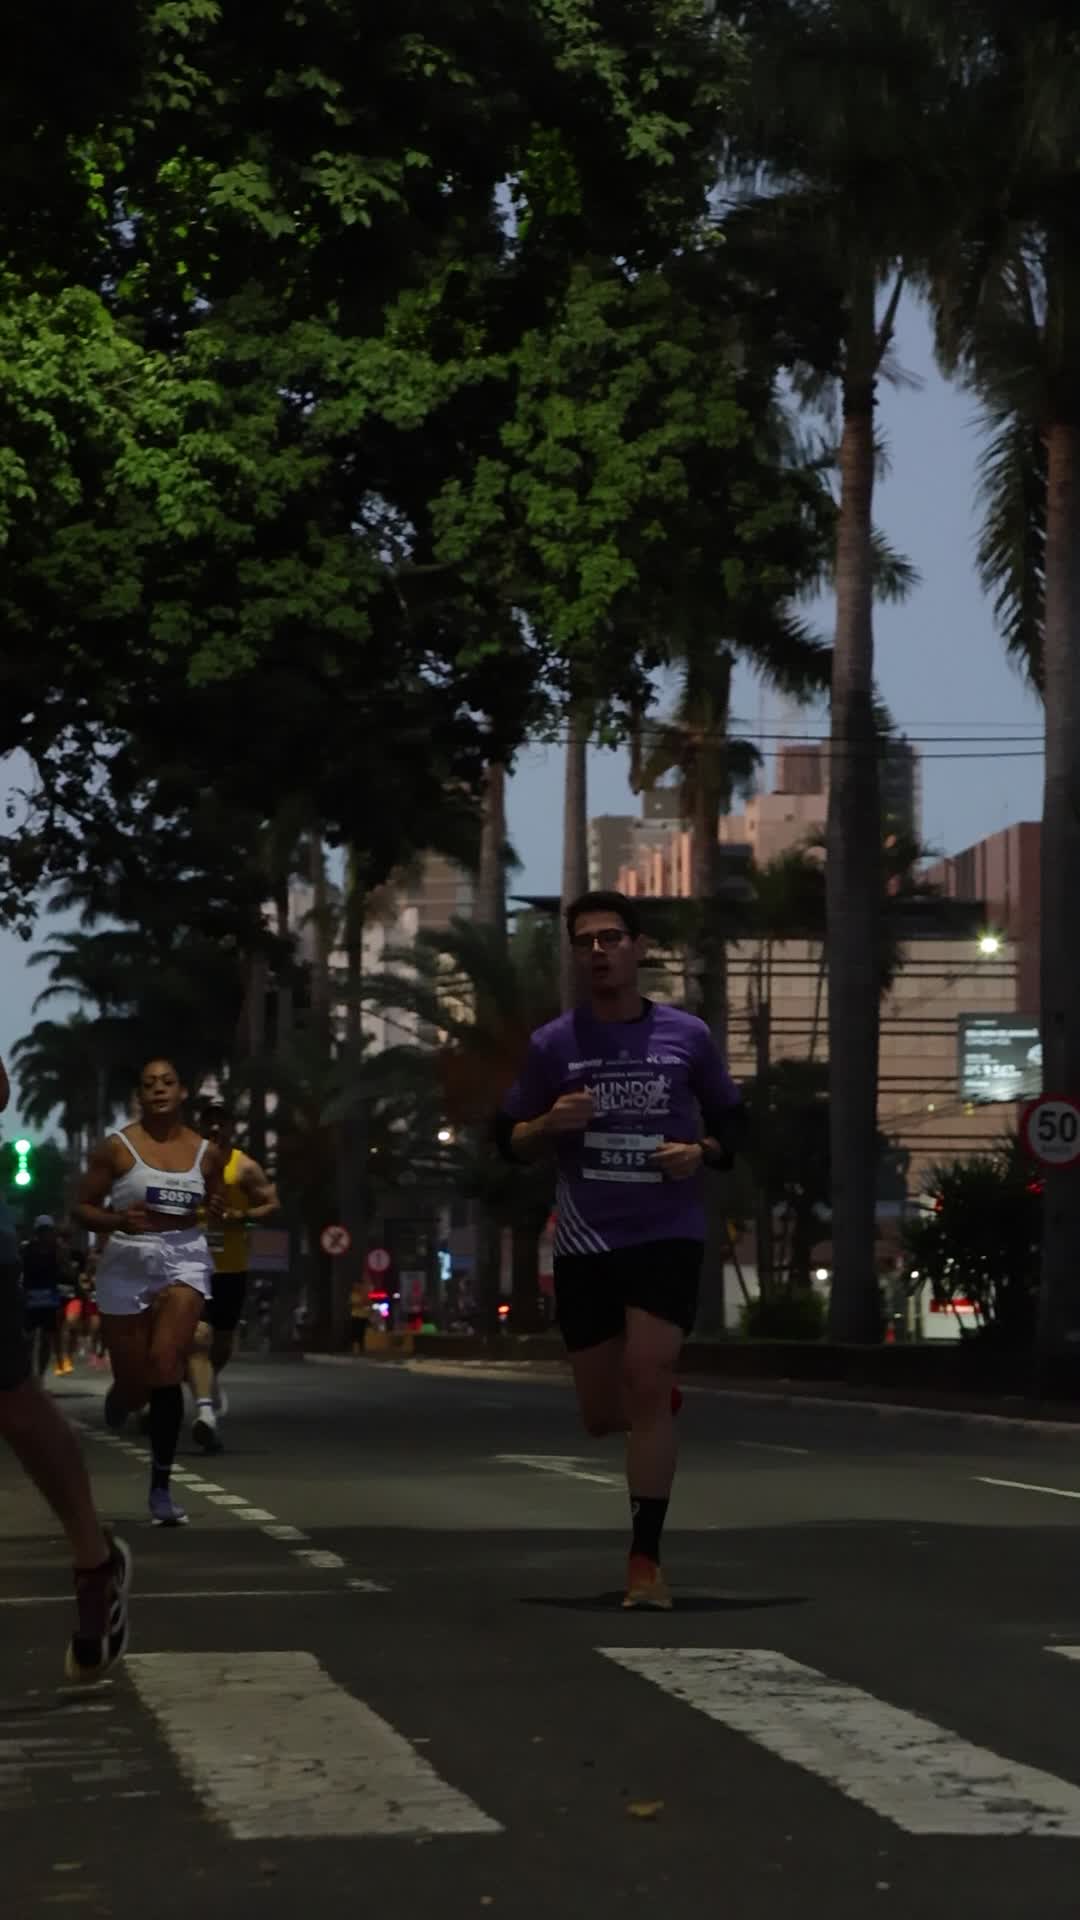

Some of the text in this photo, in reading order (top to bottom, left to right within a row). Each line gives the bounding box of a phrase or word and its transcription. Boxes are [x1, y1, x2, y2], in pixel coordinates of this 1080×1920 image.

[584, 1080, 658, 1098] MUNDO
[1039, 1110, 1077, 1142] 50
[600, 1151, 646, 1166] 5615
[159, 1190, 193, 1204] 5059
